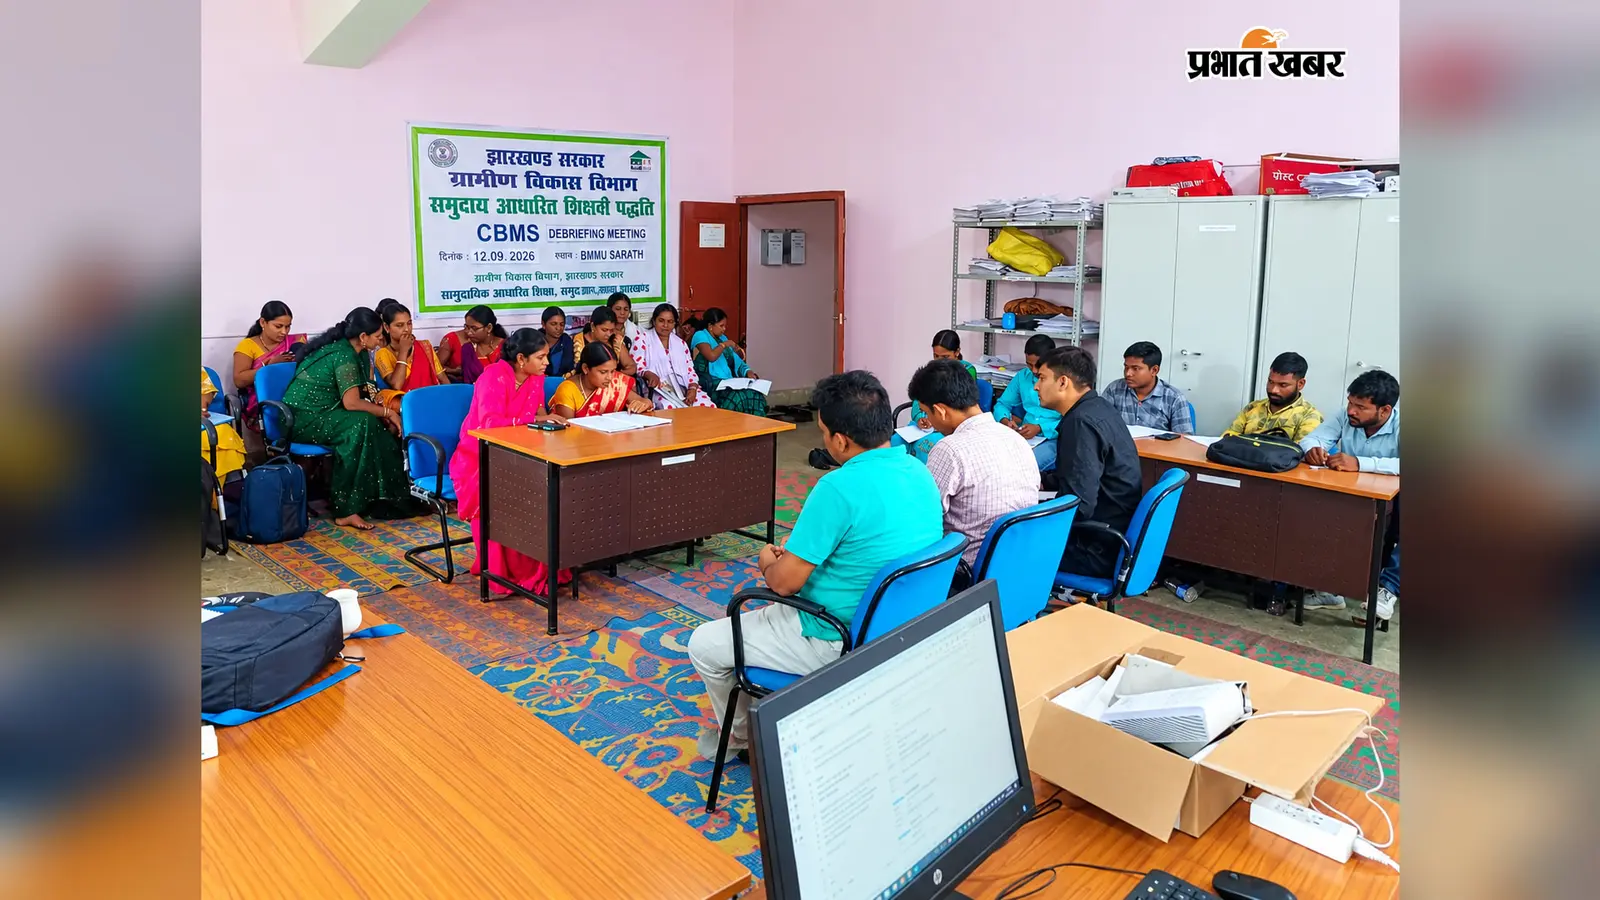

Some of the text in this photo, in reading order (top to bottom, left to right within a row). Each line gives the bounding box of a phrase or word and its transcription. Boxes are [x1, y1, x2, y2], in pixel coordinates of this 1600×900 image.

[485, 149, 606, 169] झारखण्ड सरकार
[448, 169, 639, 192] ग्रामीण विकास विभाग
[428, 197, 490, 220] समुदाय
[496, 195, 559, 215] आधारित
[614, 197, 656, 219] पद्धति
[476, 223, 647, 243] CBMS DEBRIEFING MEETING
[580, 250, 607, 261] BMMU
[609, 249, 644, 260] SARATH
